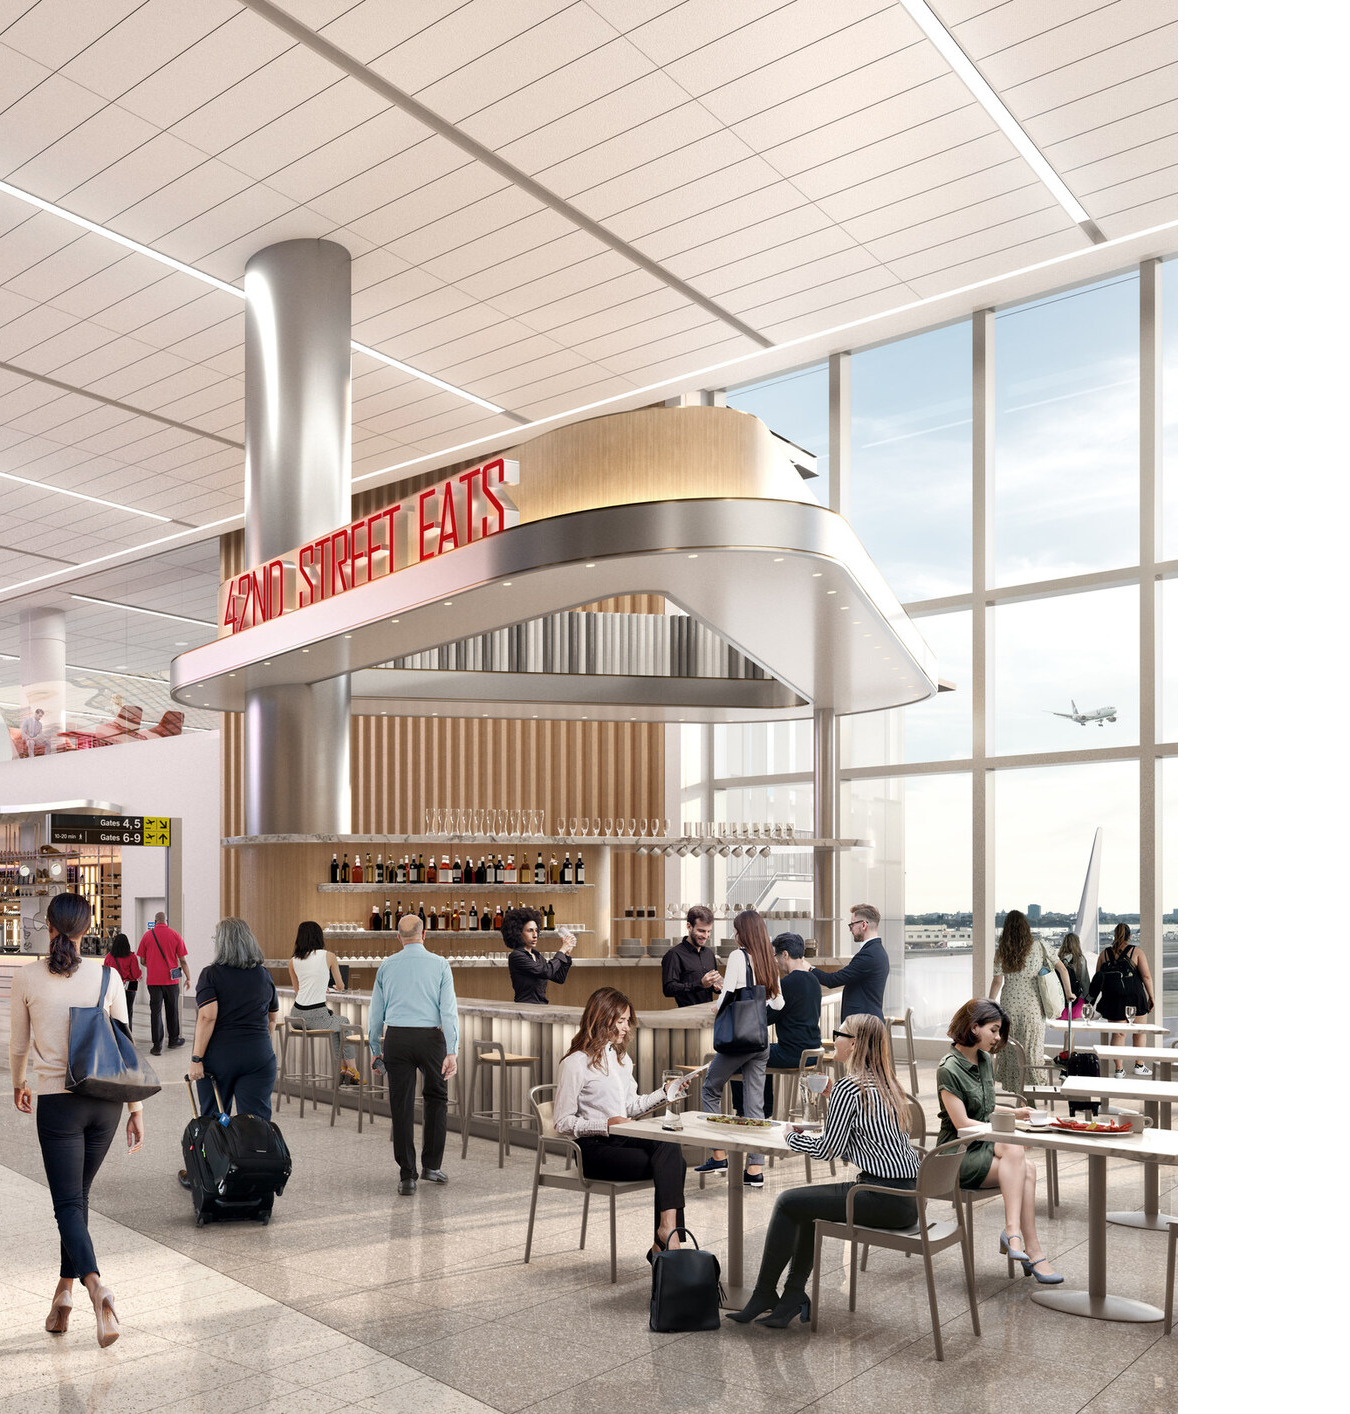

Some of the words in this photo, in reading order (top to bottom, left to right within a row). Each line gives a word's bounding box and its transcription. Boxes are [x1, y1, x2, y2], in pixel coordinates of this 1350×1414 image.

[224, 560, 284, 634] 42ND
[299, 504, 400, 608] STREET
[419, 458, 505, 561] EATS
[100, 819, 120, 827] Gates
[122, 833, 141, 843] 6-9
